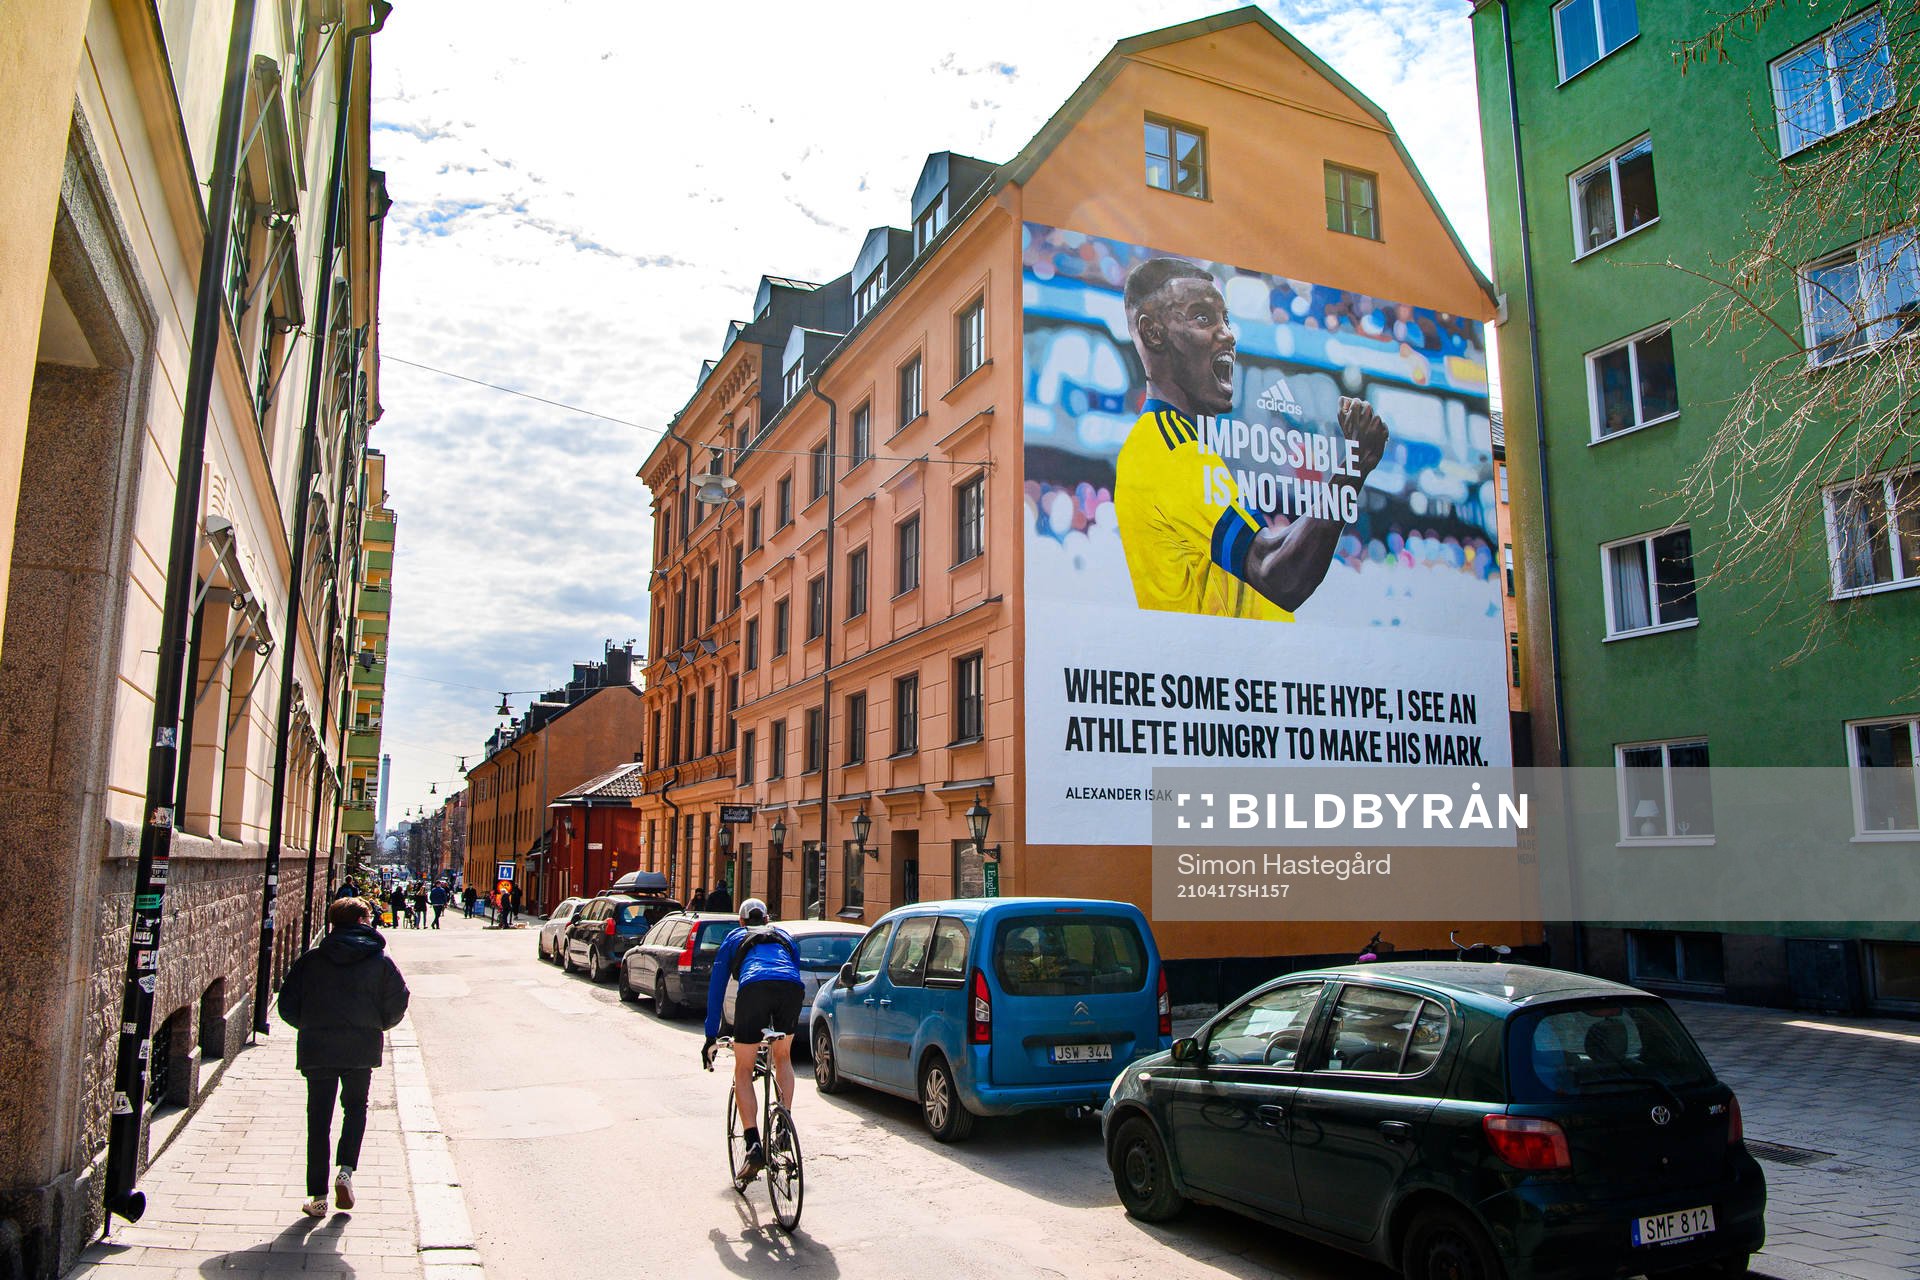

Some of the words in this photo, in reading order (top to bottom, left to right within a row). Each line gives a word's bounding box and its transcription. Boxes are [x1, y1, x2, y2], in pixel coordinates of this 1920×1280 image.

[1256, 398, 1303, 416] adidas
[1196, 414, 1361, 477] IMPOSSIBLE
[1203, 465, 1231, 507] IS
[1237, 469, 1358, 524] NOTHING
[1064, 667, 1156, 707] WHERE
[1161, 674, 1230, 711] SOME
[1235, 678, 1278, 714] SEE
[1282, 681, 1326, 716] THE
[1331, 685, 1393, 723] HYPE,
[1397, 689, 1404, 721] I
[1408, 690, 1445, 723] SEE
[1449, 693, 1477, 725] AN
[1065, 716, 1178, 755] ATHLETE
[1183, 722, 1279, 759] HUNGRY
[1285, 727, 1315, 760] TO
[1319, 728, 1382, 763] MAKE
[1386, 732, 1421, 765] HIS
[1425, 734, 1489, 767] MARK.
[1065, 787, 1141, 801] ALEXANDER
[1145, 789, 1173, 802] ISAK
[1057, 1046, 1079, 1059] JSW
[1088, 1046, 1110, 1058] 344
[1646, 1215, 1675, 1240] SMF
[1681, 1209, 1709, 1234] 812
